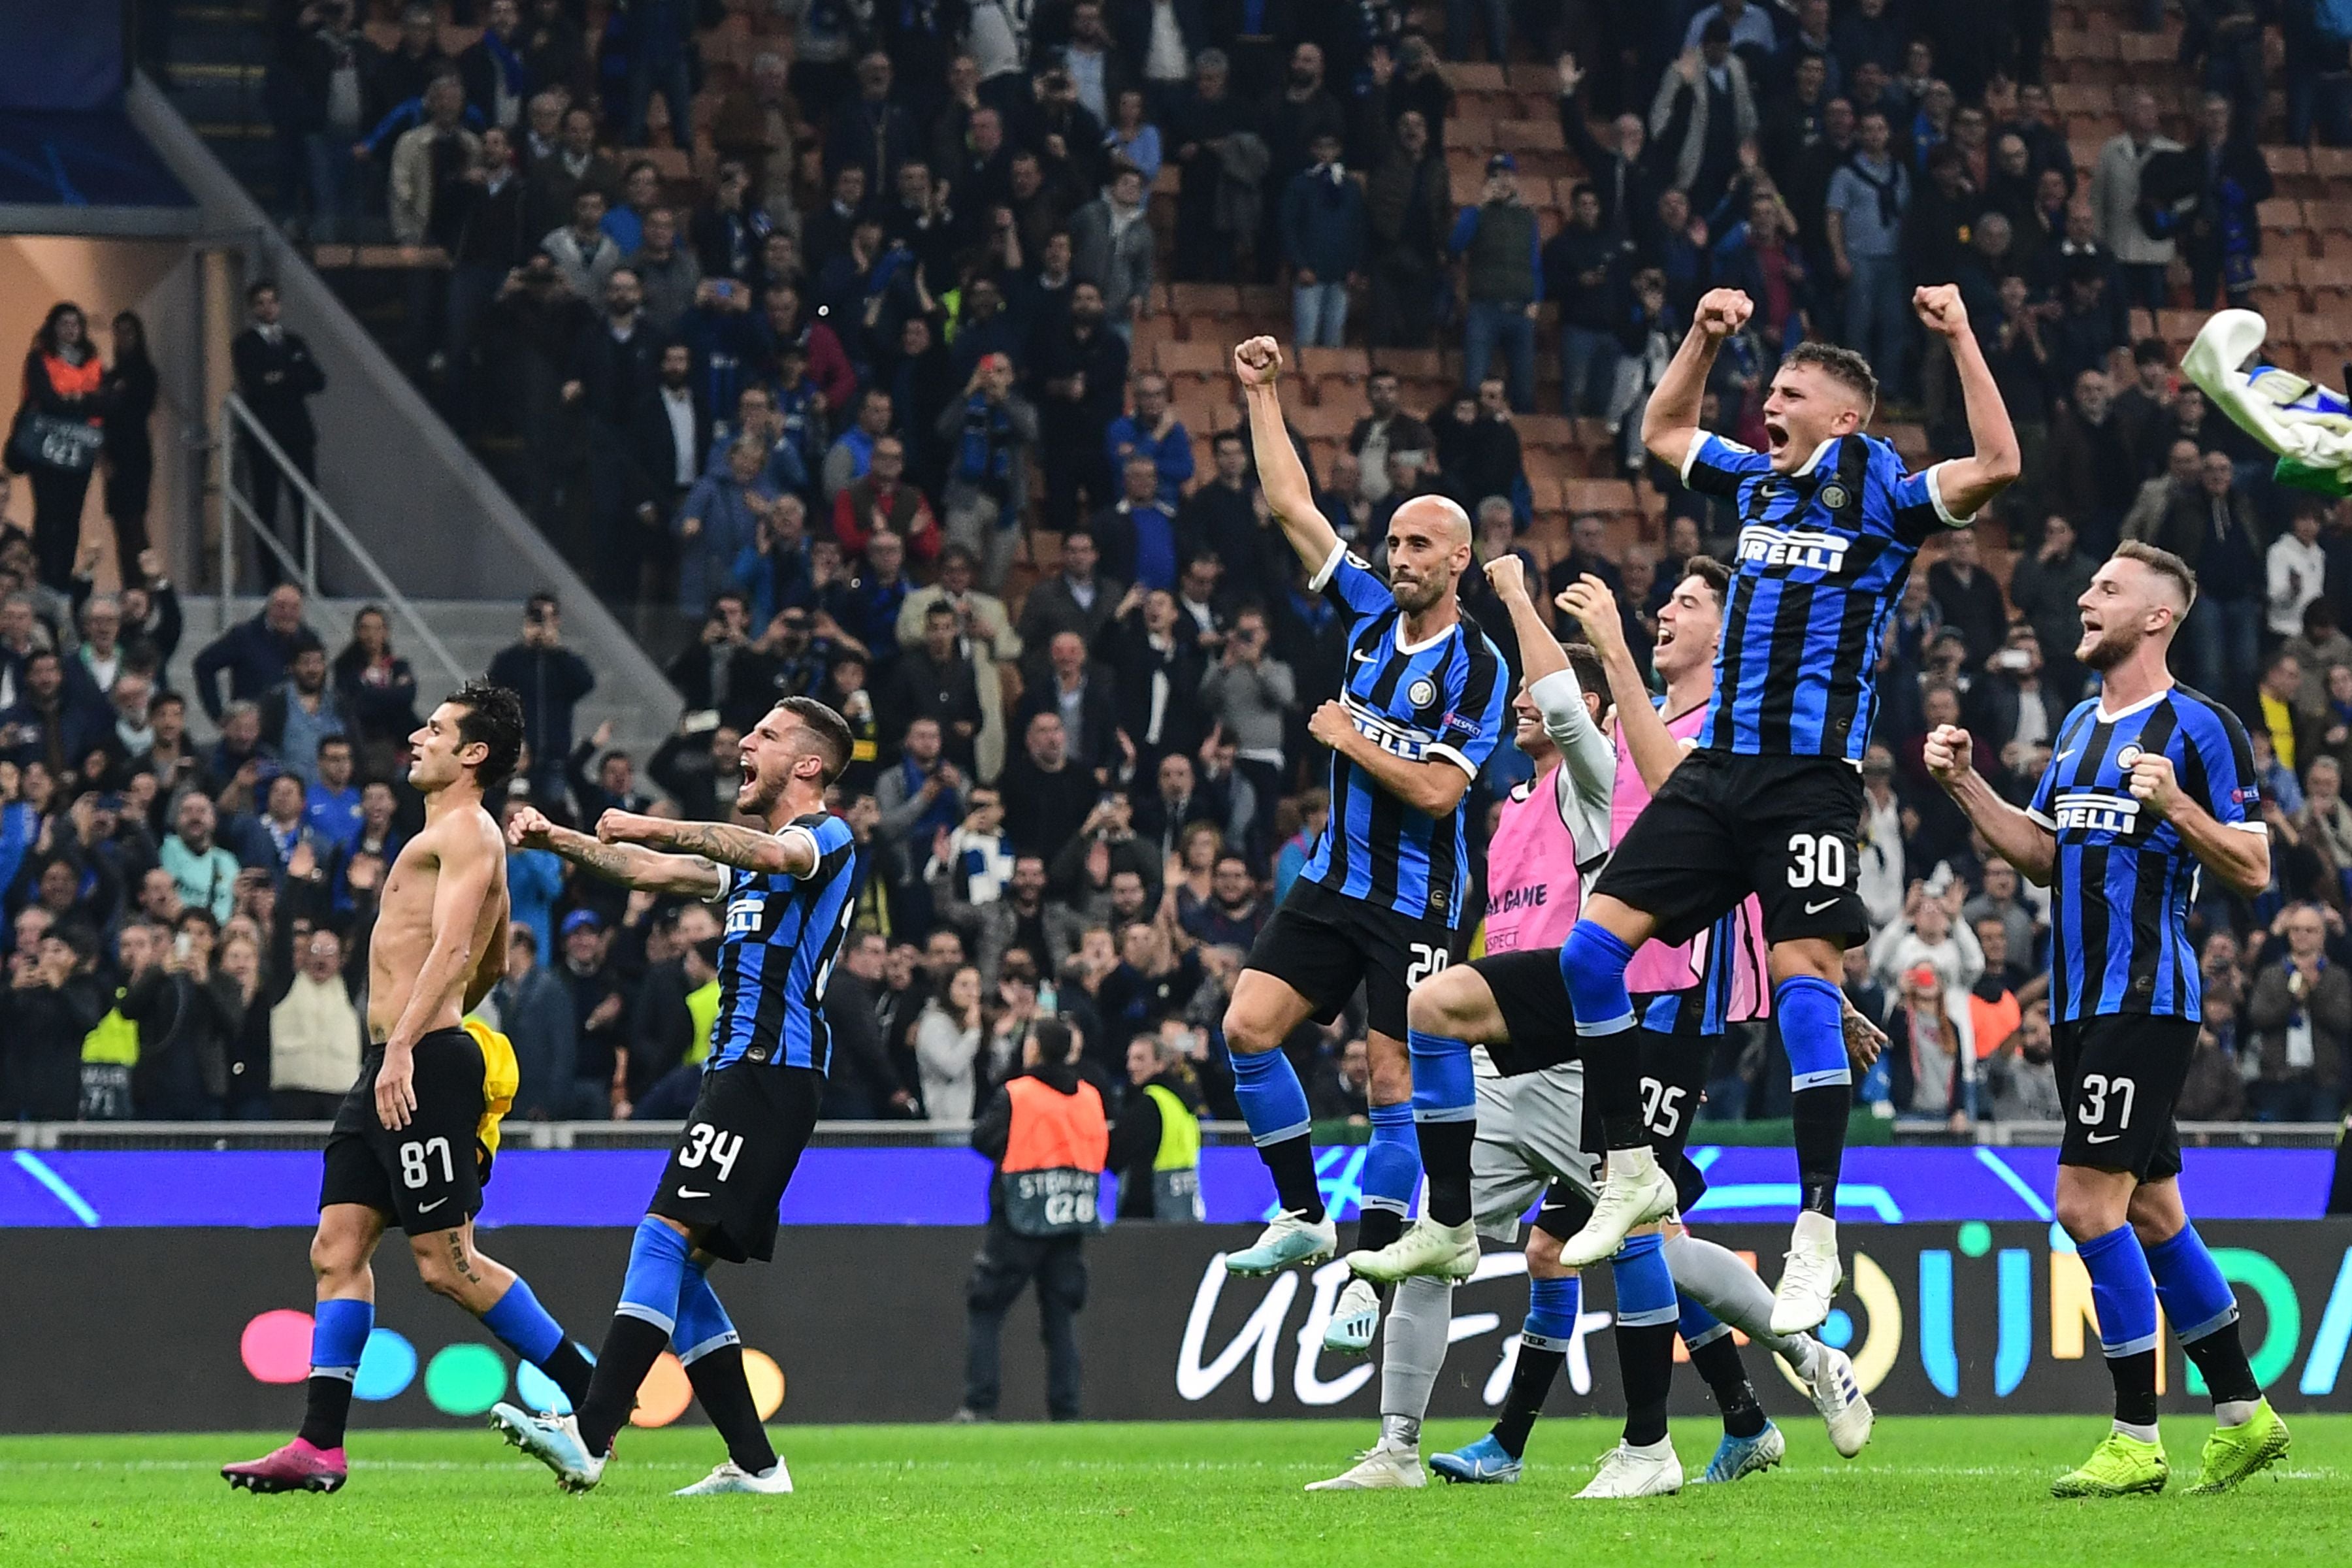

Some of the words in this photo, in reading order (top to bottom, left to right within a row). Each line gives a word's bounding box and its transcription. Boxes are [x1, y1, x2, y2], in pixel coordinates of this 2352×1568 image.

[1452, 717, 1482, 736] RESPECT
[1787, 834, 1845, 888] 30
[1503, 884, 1548, 913] GAME
[1485, 931, 1519, 952] SPECT
[1406, 943, 1448, 991] 20
[2078, 1074, 2135, 1130] 37
[400, 1137, 454, 1189] 87
[678, 1122, 744, 1182] 34
[1522, 1333, 1548, 1347] TER
